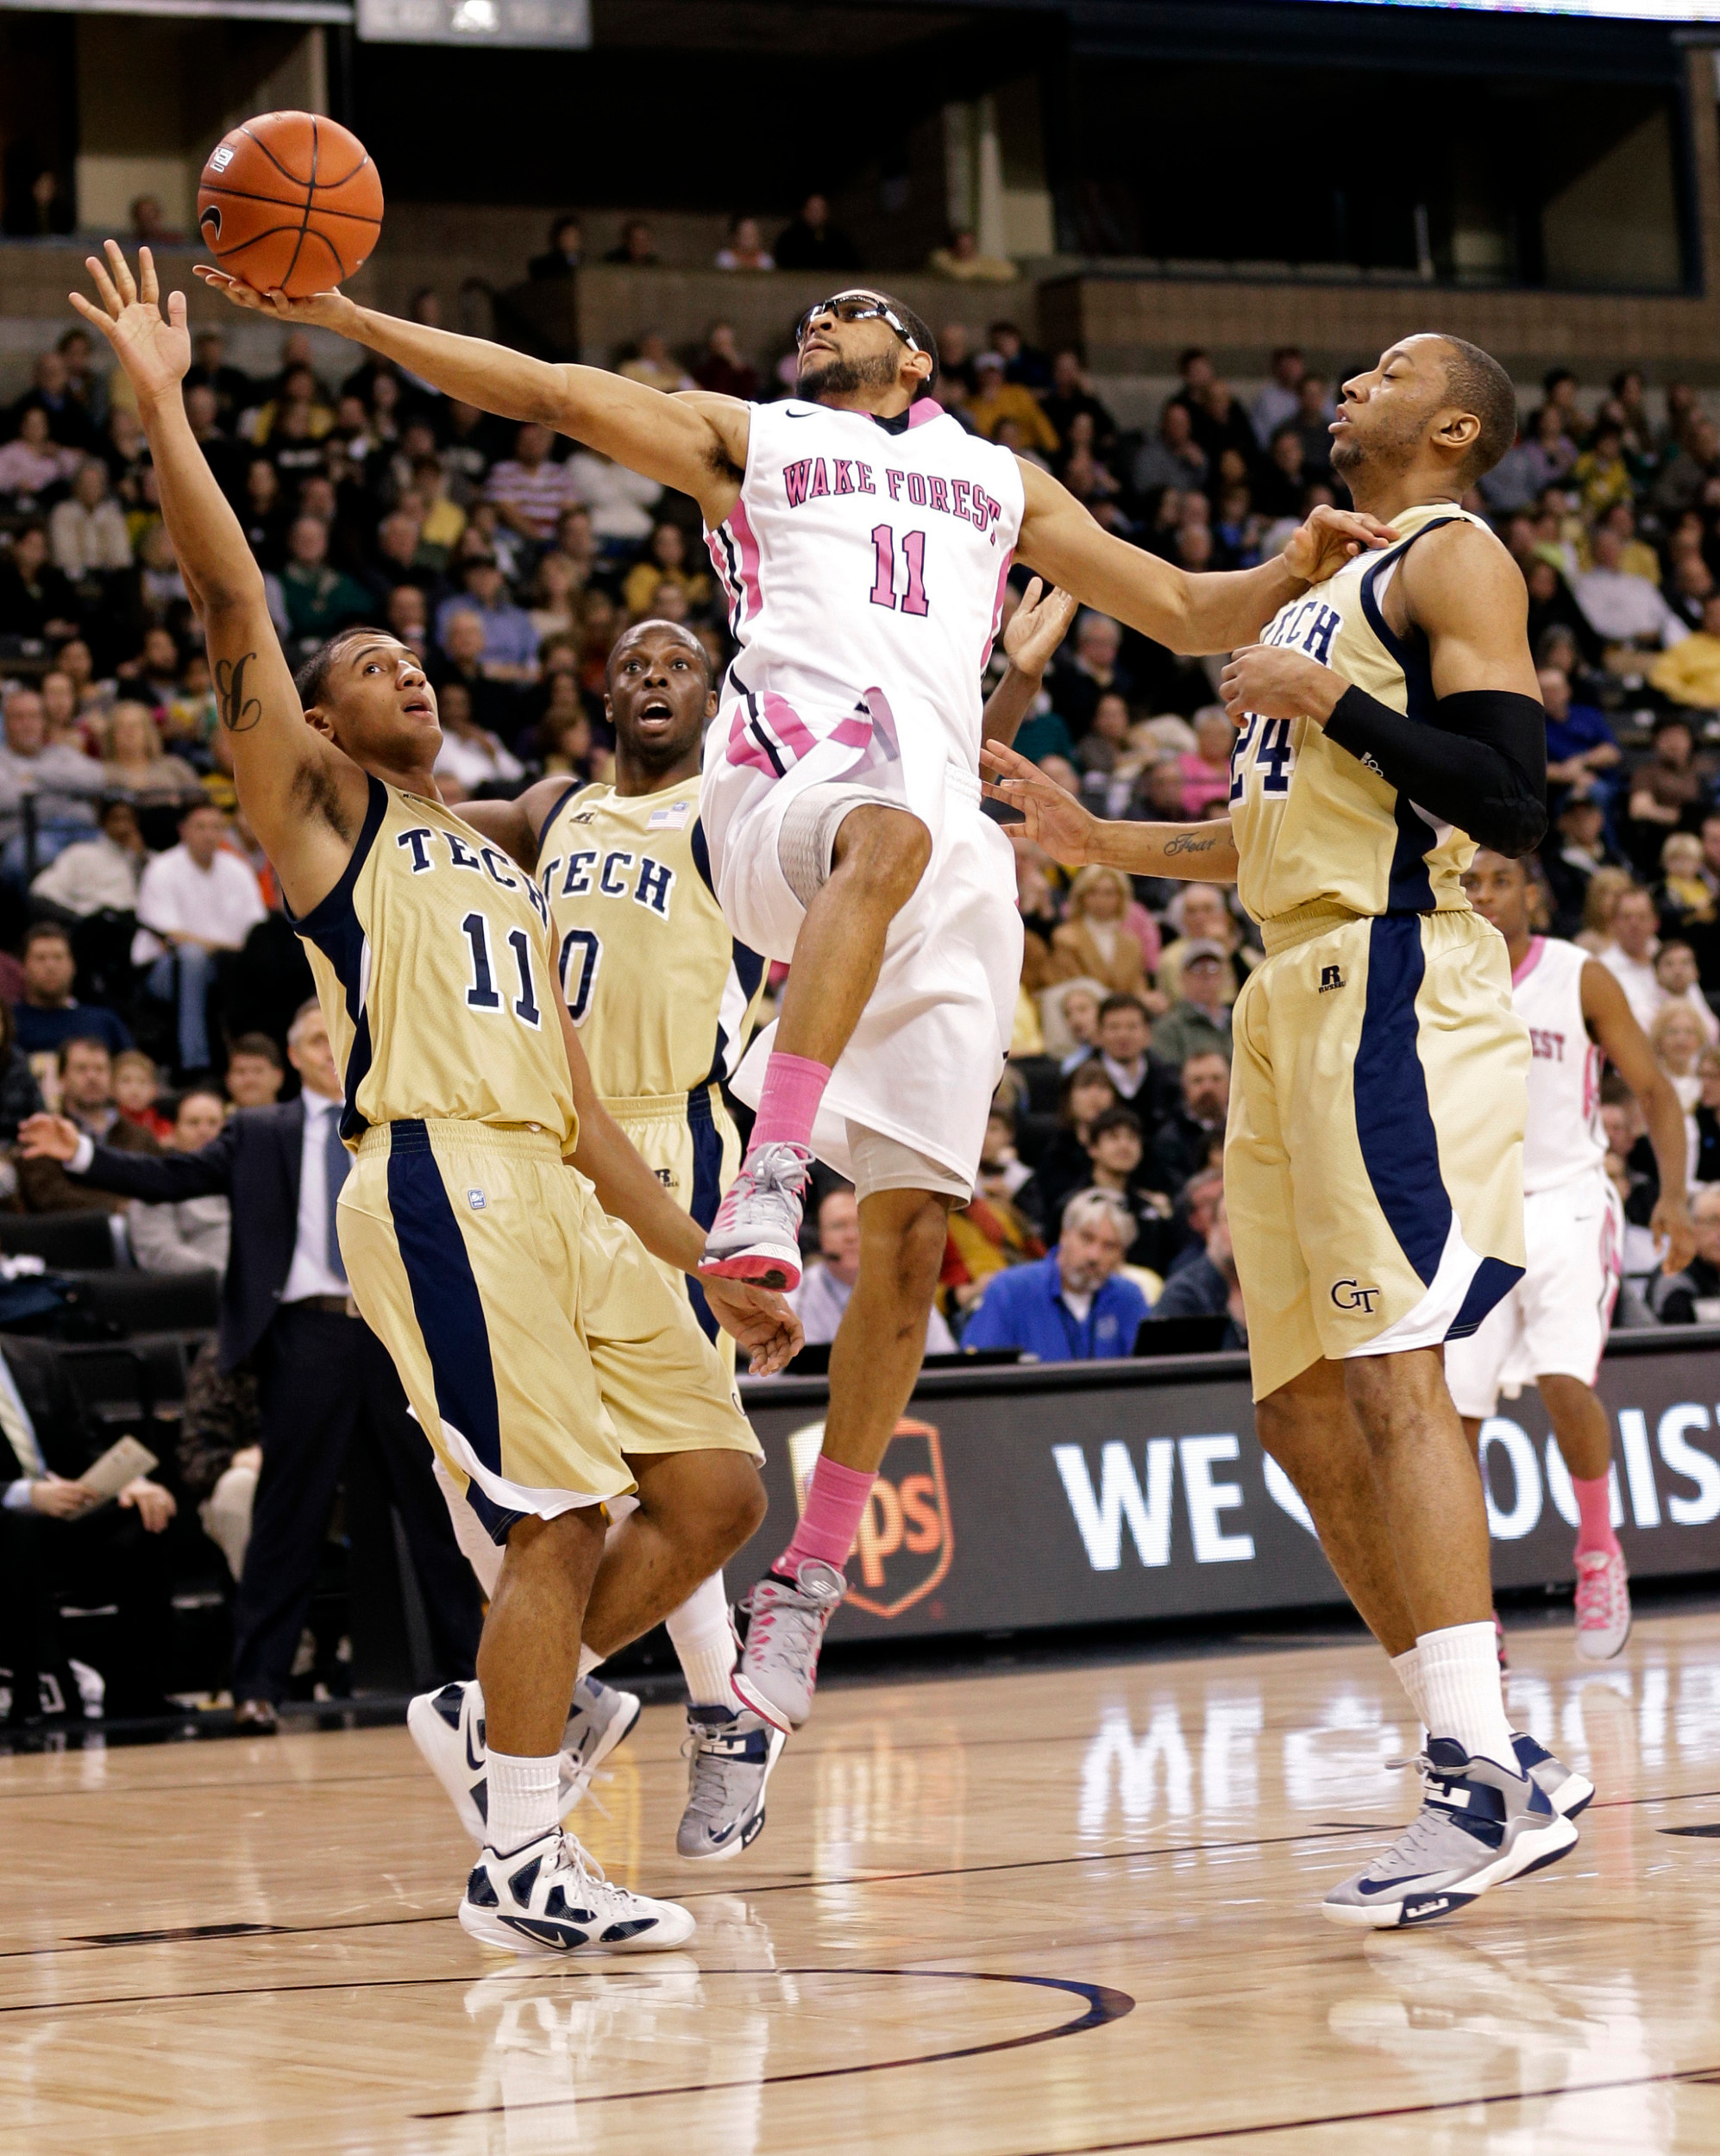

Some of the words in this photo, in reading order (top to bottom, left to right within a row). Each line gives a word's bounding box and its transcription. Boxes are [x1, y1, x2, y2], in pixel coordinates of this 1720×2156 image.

[783, 457, 876, 508] WAKE
[885, 468, 1001, 546] FOREST
[869, 523, 929, 617] 11
[396, 827, 549, 933] TECH
[1164, 830, 1216, 856] Fear
[461, 912, 542, 1031] 11
[1331, 1279, 1380, 1313] GT
[847, 1473, 942, 1589] ps
[1051, 1434, 1256, 1571] WE
